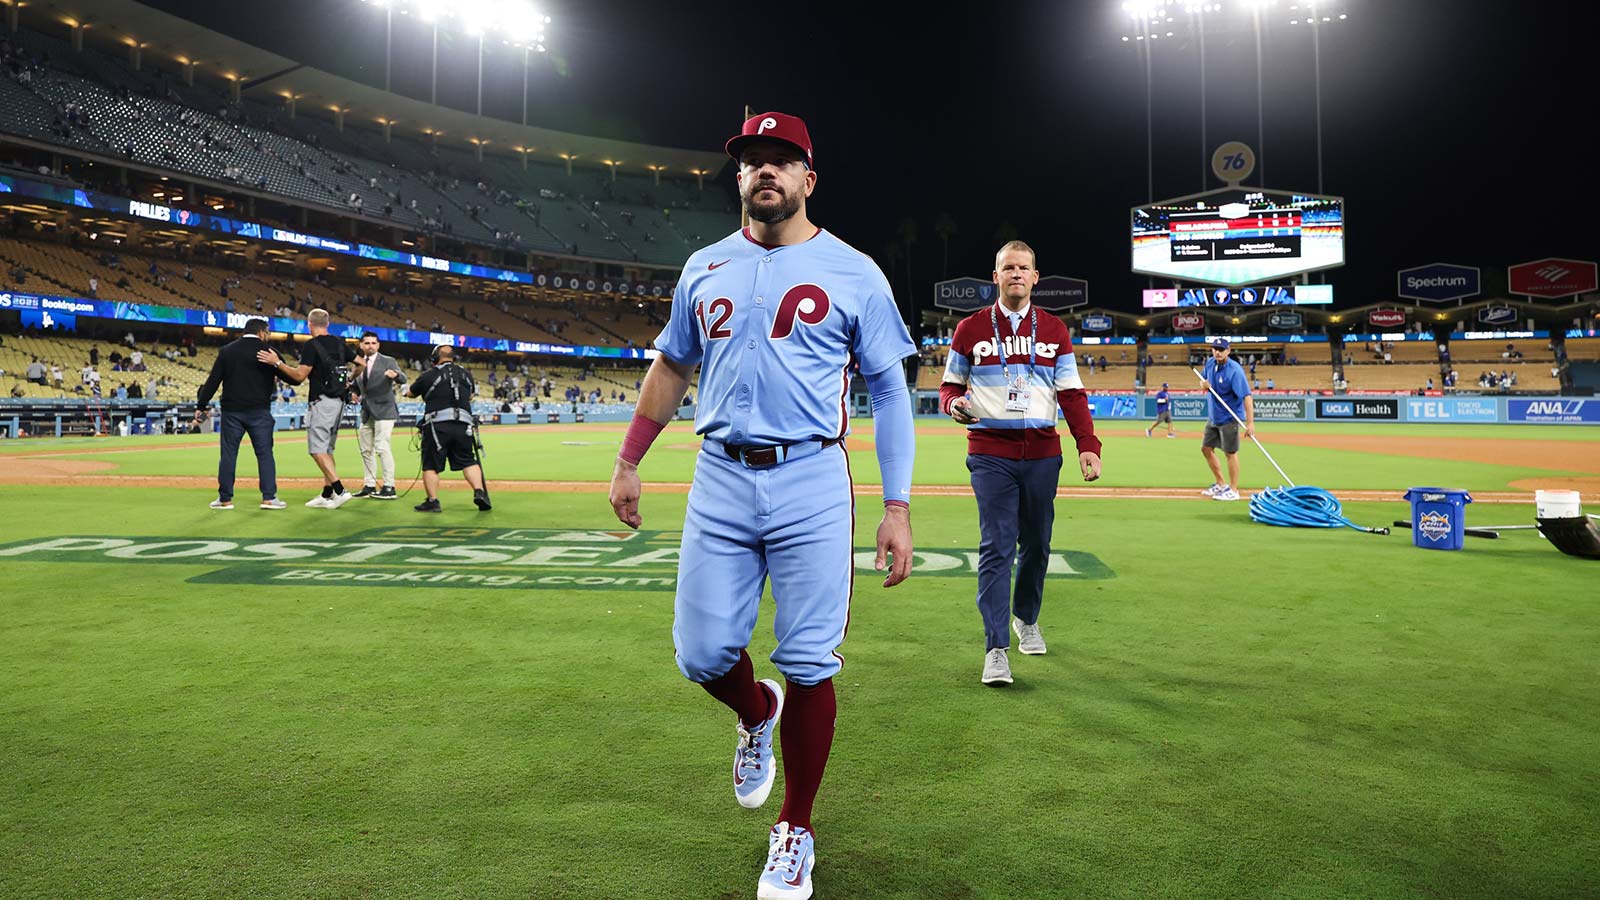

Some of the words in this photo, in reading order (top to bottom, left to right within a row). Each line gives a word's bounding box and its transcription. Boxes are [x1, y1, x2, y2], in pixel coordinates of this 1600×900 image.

[758, 117, 777, 135] P
[1223, 152, 1245, 170] 76
[129, 200, 171, 221] PHILLIES
[1407, 276, 1467, 289] Spectrum
[941, 285, 976, 298] blue
[42, 299, 94, 312] Booking.com
[770, 282, 831, 340] P
[695, 297, 735, 340] 12
[973, 335, 1060, 366] phillies
[1174, 400, 1206, 410] Security
[1174, 407, 1202, 416] Benefit
[1326, 405, 1350, 413] UCLA
[1356, 404, 1391, 415] Health
[1410, 402, 1449, 417] TEL
[1526, 402, 1563, 414] ANA
[274, 569, 674, 585] Booking.com
